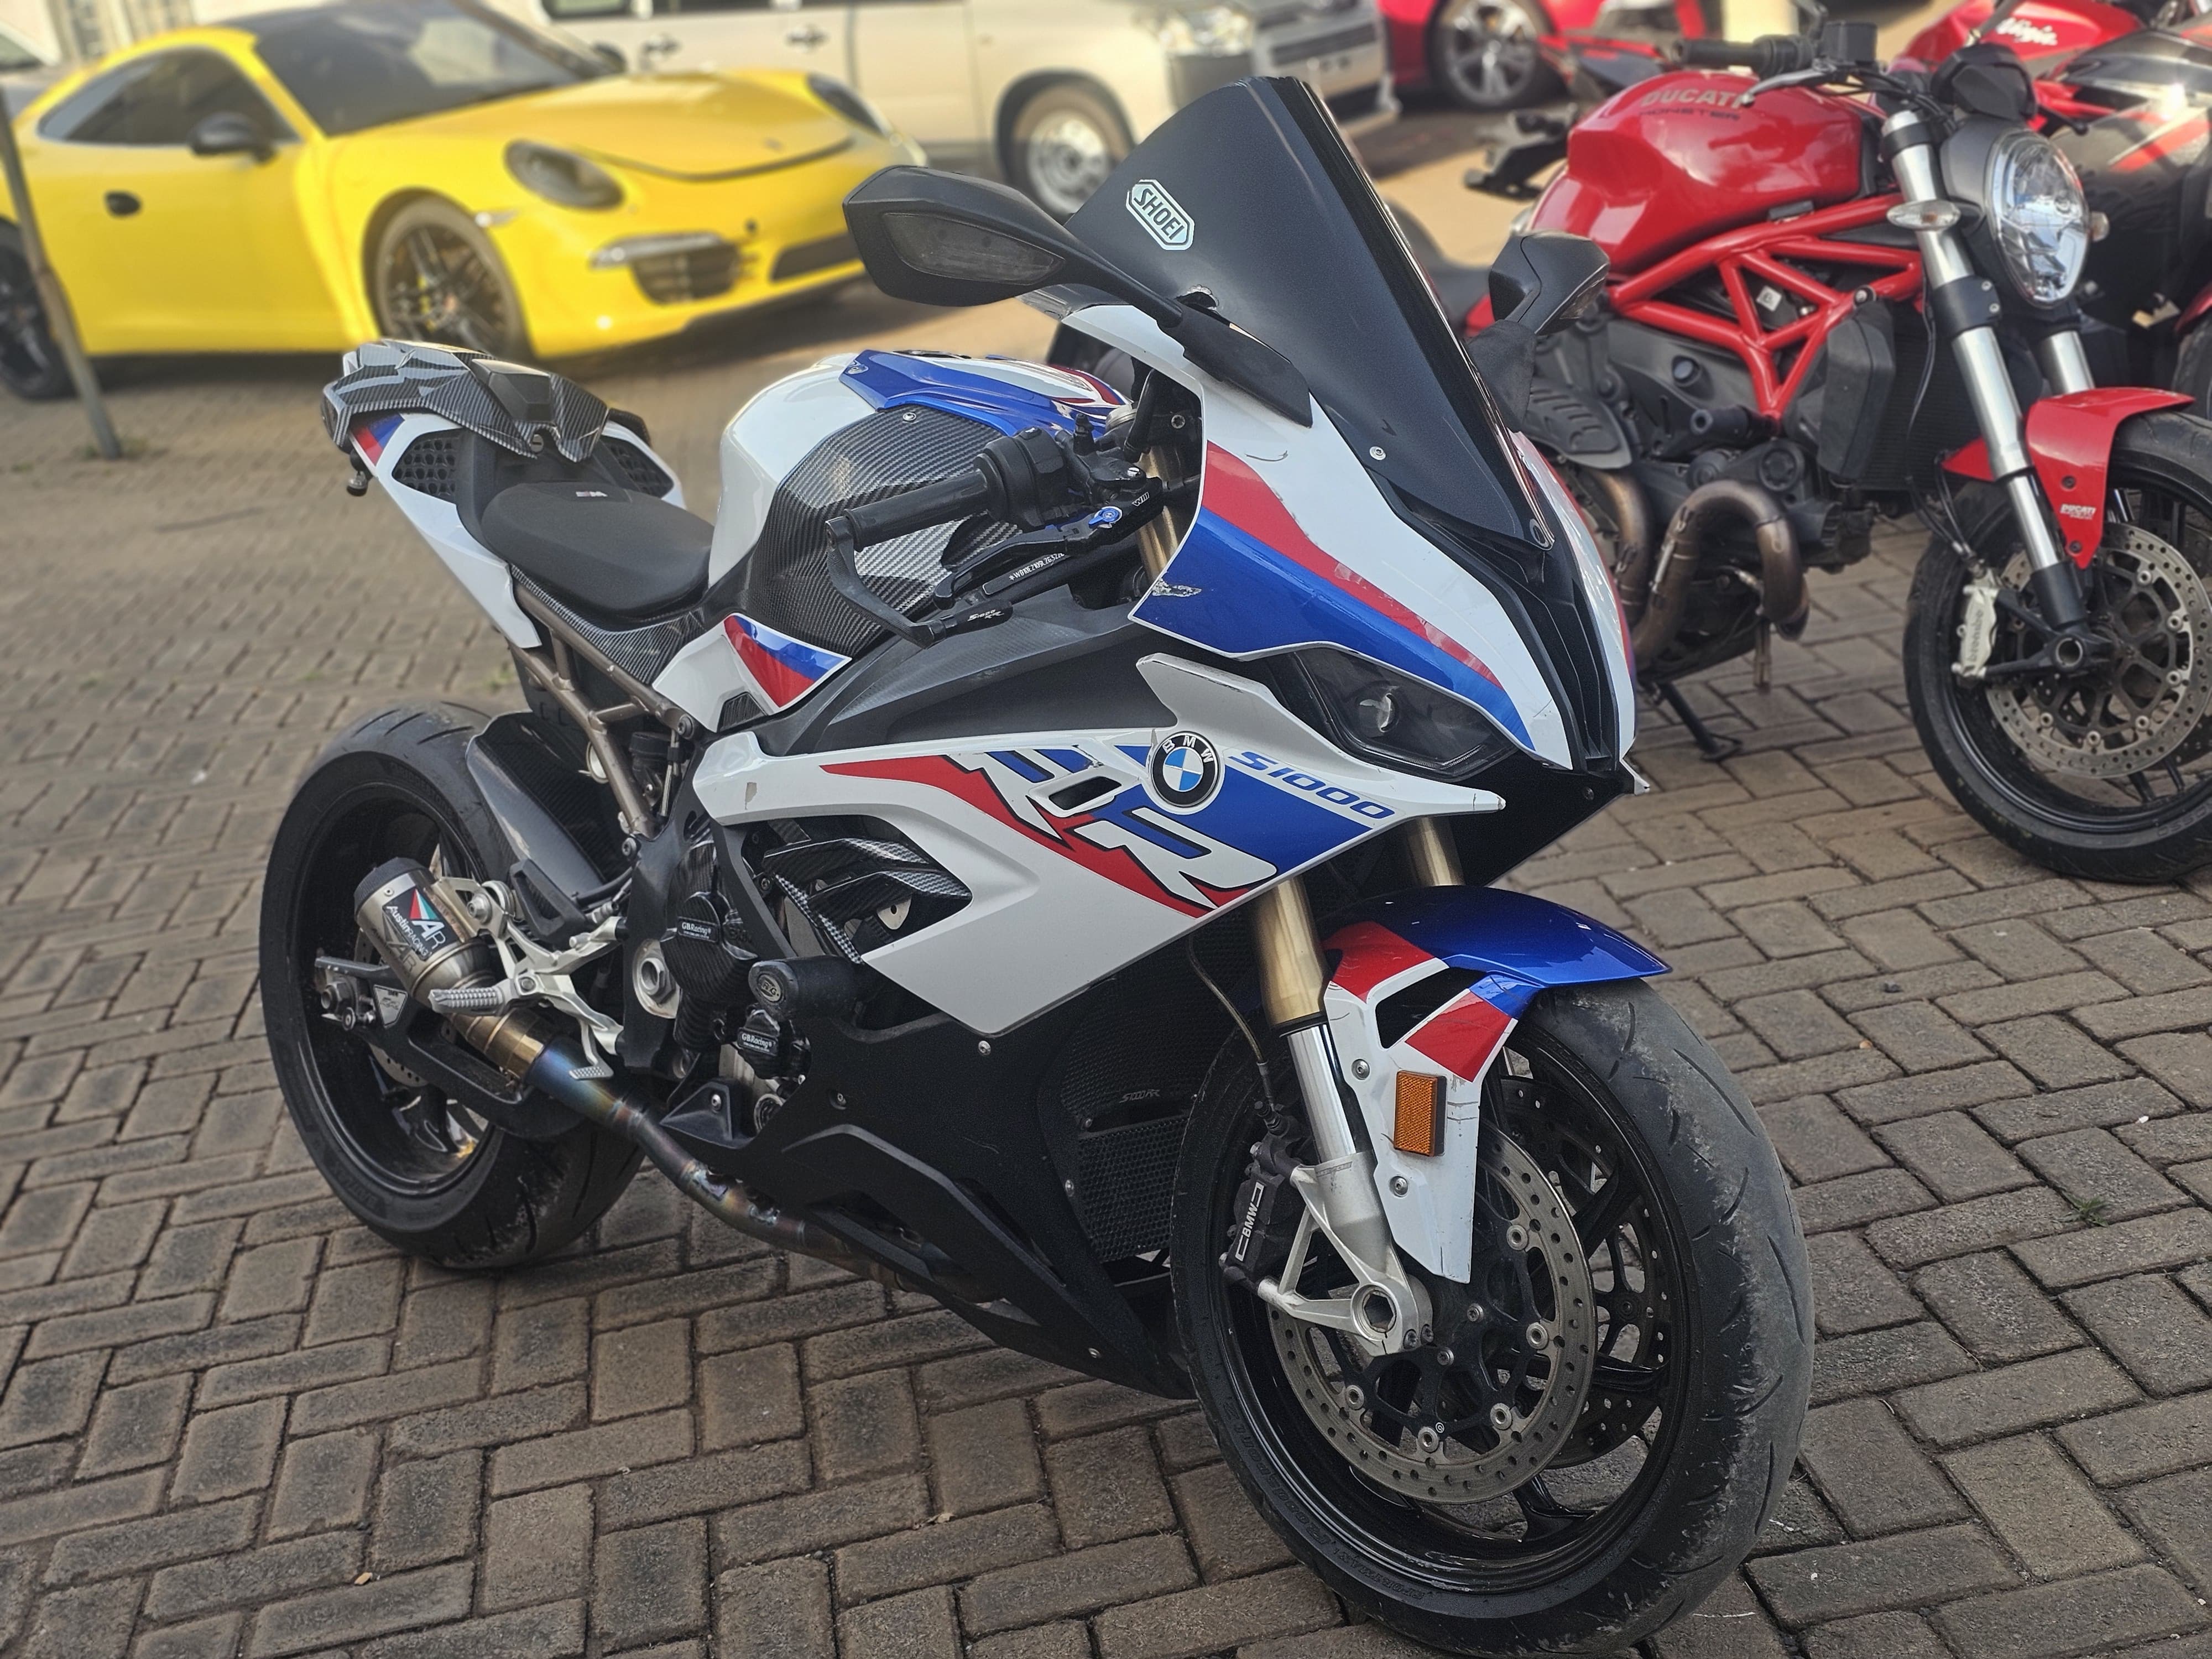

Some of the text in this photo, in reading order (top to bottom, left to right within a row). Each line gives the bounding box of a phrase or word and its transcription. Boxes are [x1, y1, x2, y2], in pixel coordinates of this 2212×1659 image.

[1134, 188, 1185, 240] SHOEI
[1162, 735, 1214, 764] BMW
[1227, 751, 1395, 819] S1000
[411, 920, 446, 950] AR
[1242, 1202, 1258, 1238] BMW
